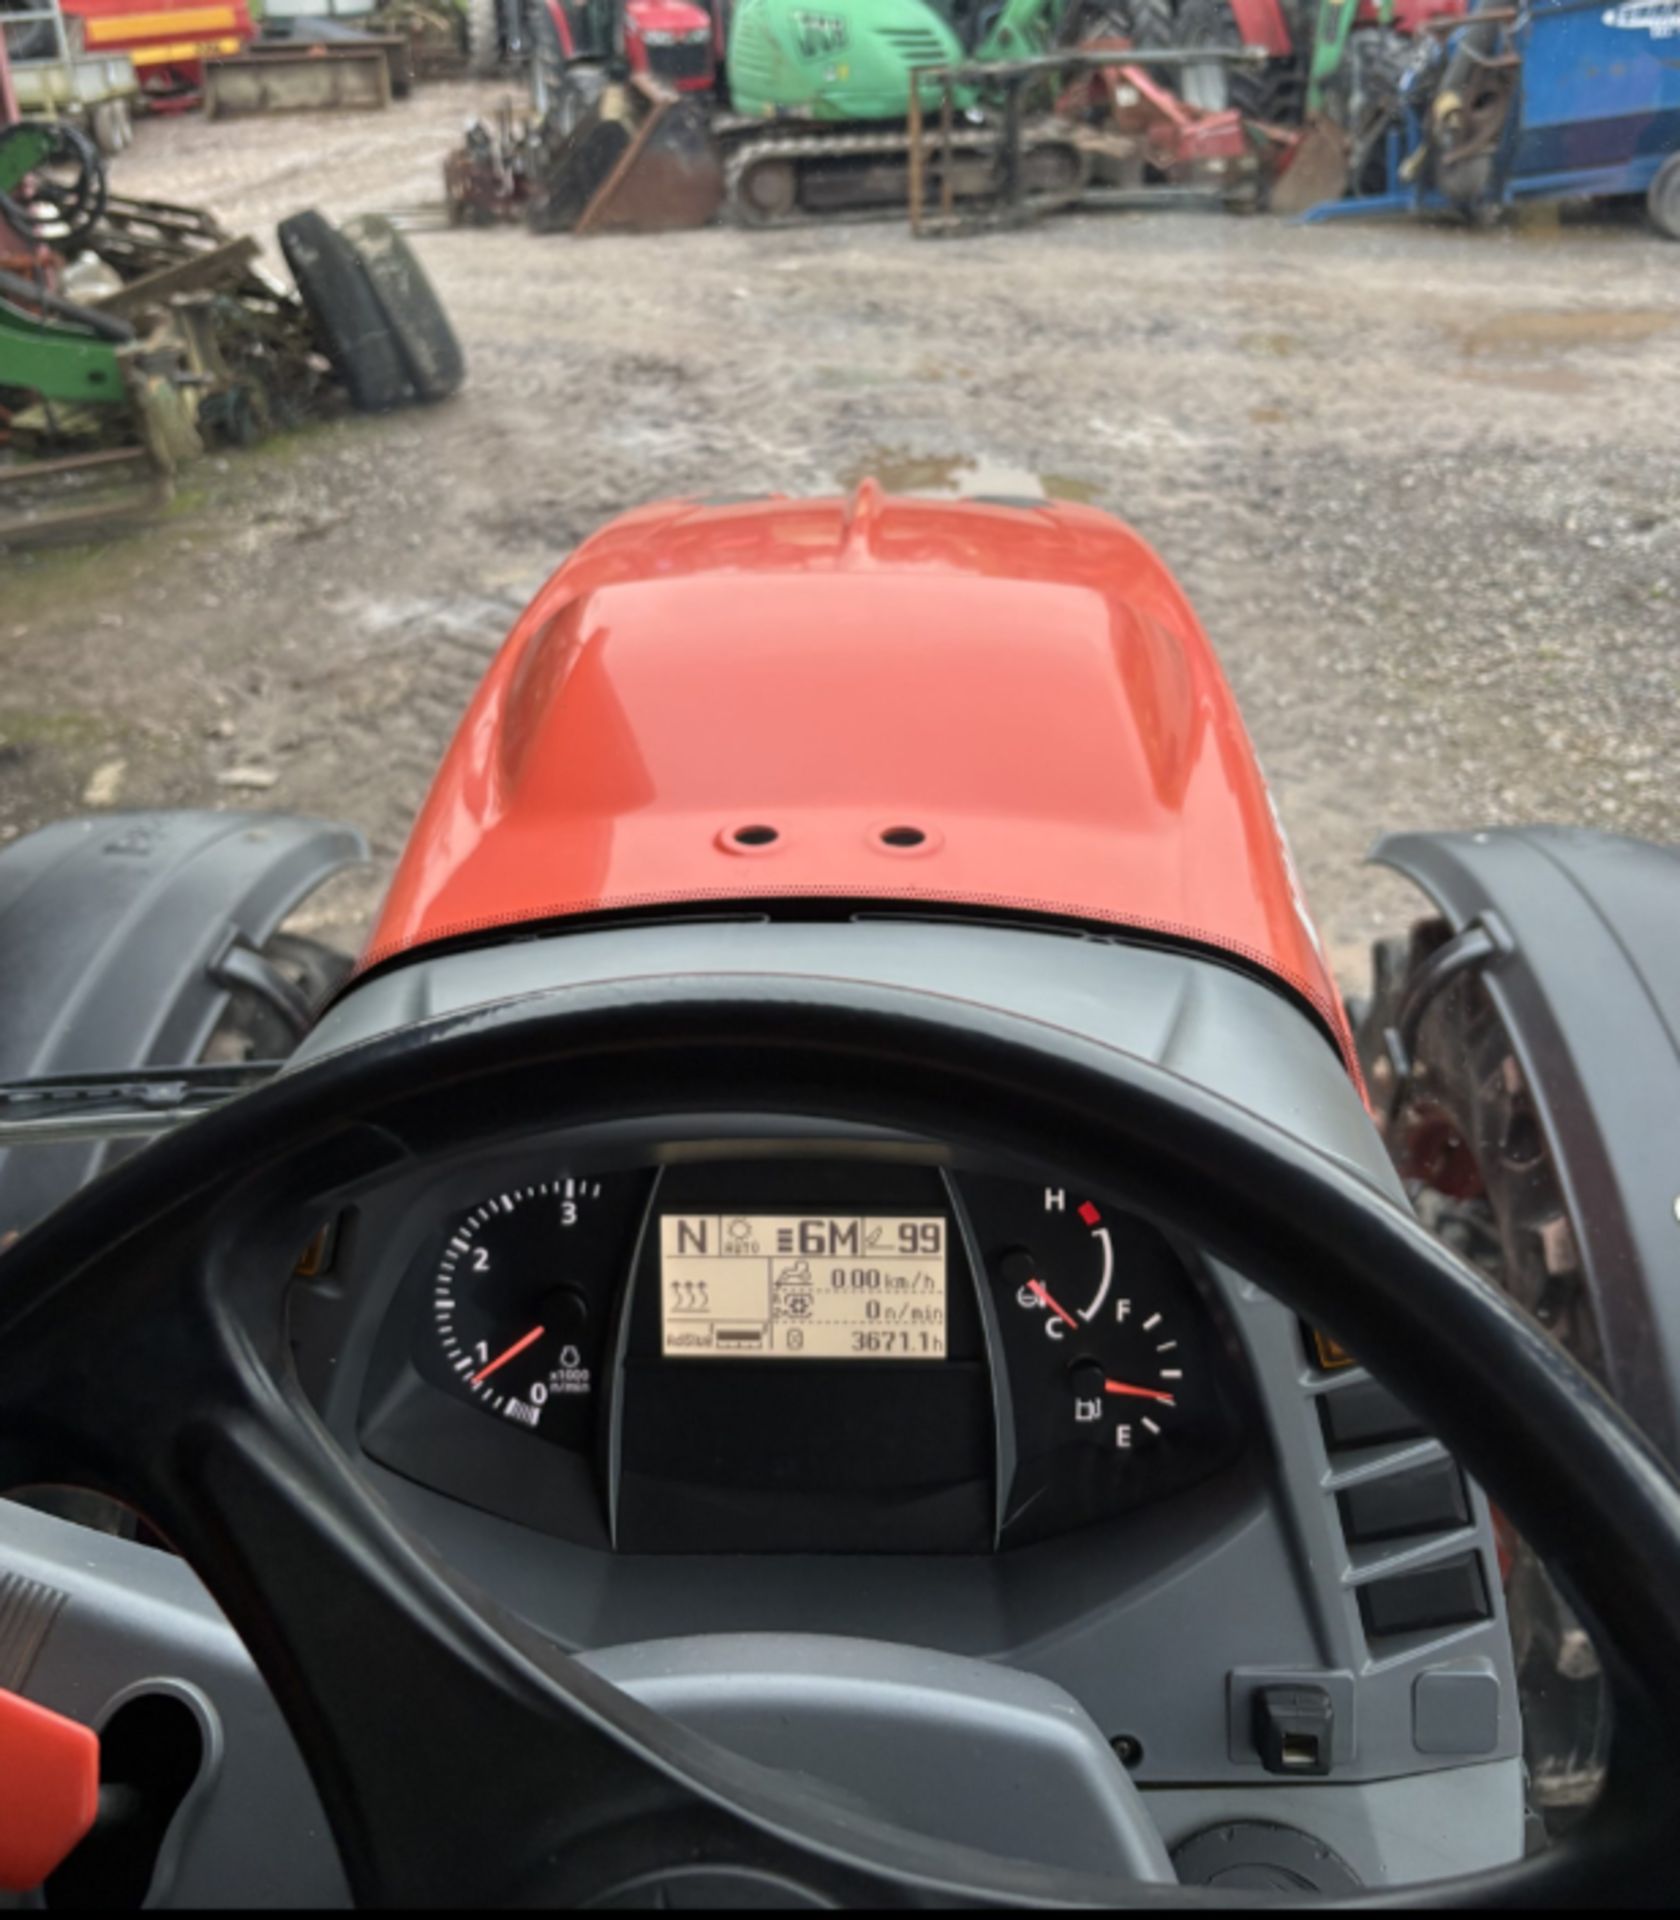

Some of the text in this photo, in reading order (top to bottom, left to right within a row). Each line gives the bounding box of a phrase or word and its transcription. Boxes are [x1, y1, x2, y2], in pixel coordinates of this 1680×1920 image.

[1045, 1188, 1065, 1211] H
[561, 1202, 577, 1226] 3
[677, 1220, 707, 1254] N
[799, 1220, 858, 1255] 6M
[898, 1223, 940, 1253] 99
[473, 1247, 490, 1272] 2
[866, 1299, 880, 1319] 0
[1116, 1299, 1131, 1322] F
[1045, 1316, 1064, 1340] C
[476, 1340, 489, 1364] 1
[530, 1382, 548, 1405] 0
[1116, 1424, 1131, 1448] E
